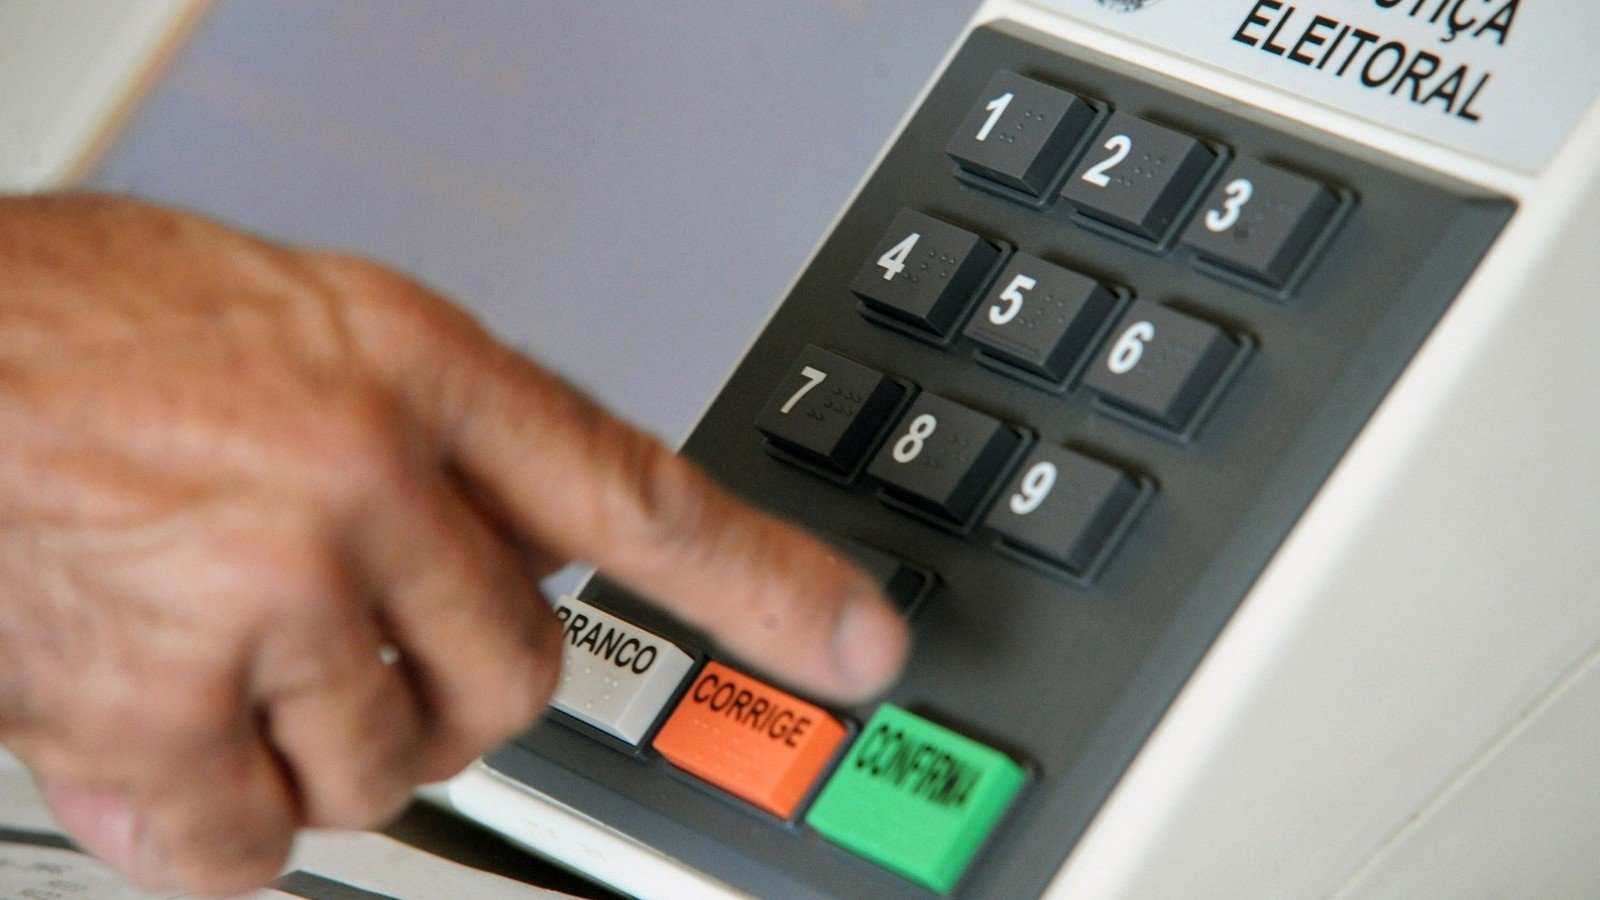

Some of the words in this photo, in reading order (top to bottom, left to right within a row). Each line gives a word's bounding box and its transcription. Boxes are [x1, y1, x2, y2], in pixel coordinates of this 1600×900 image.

[1374, 0, 1521, 45] IÇA
[1232, 0, 1490, 122] ELEITORAL
[975, 92, 1014, 141] 1
[1081, 134, 1132, 187] 2
[1205, 178, 1253, 232] 3
[876, 233, 921, 281] 4
[988, 274, 1037, 325] 5
[1107, 321, 1155, 374] 6
[780, 366, 827, 414] 7
[893, 414, 937, 463] 8
[1010, 461, 1057, 515] 9
[692, 673, 811, 748] CORRIGE
